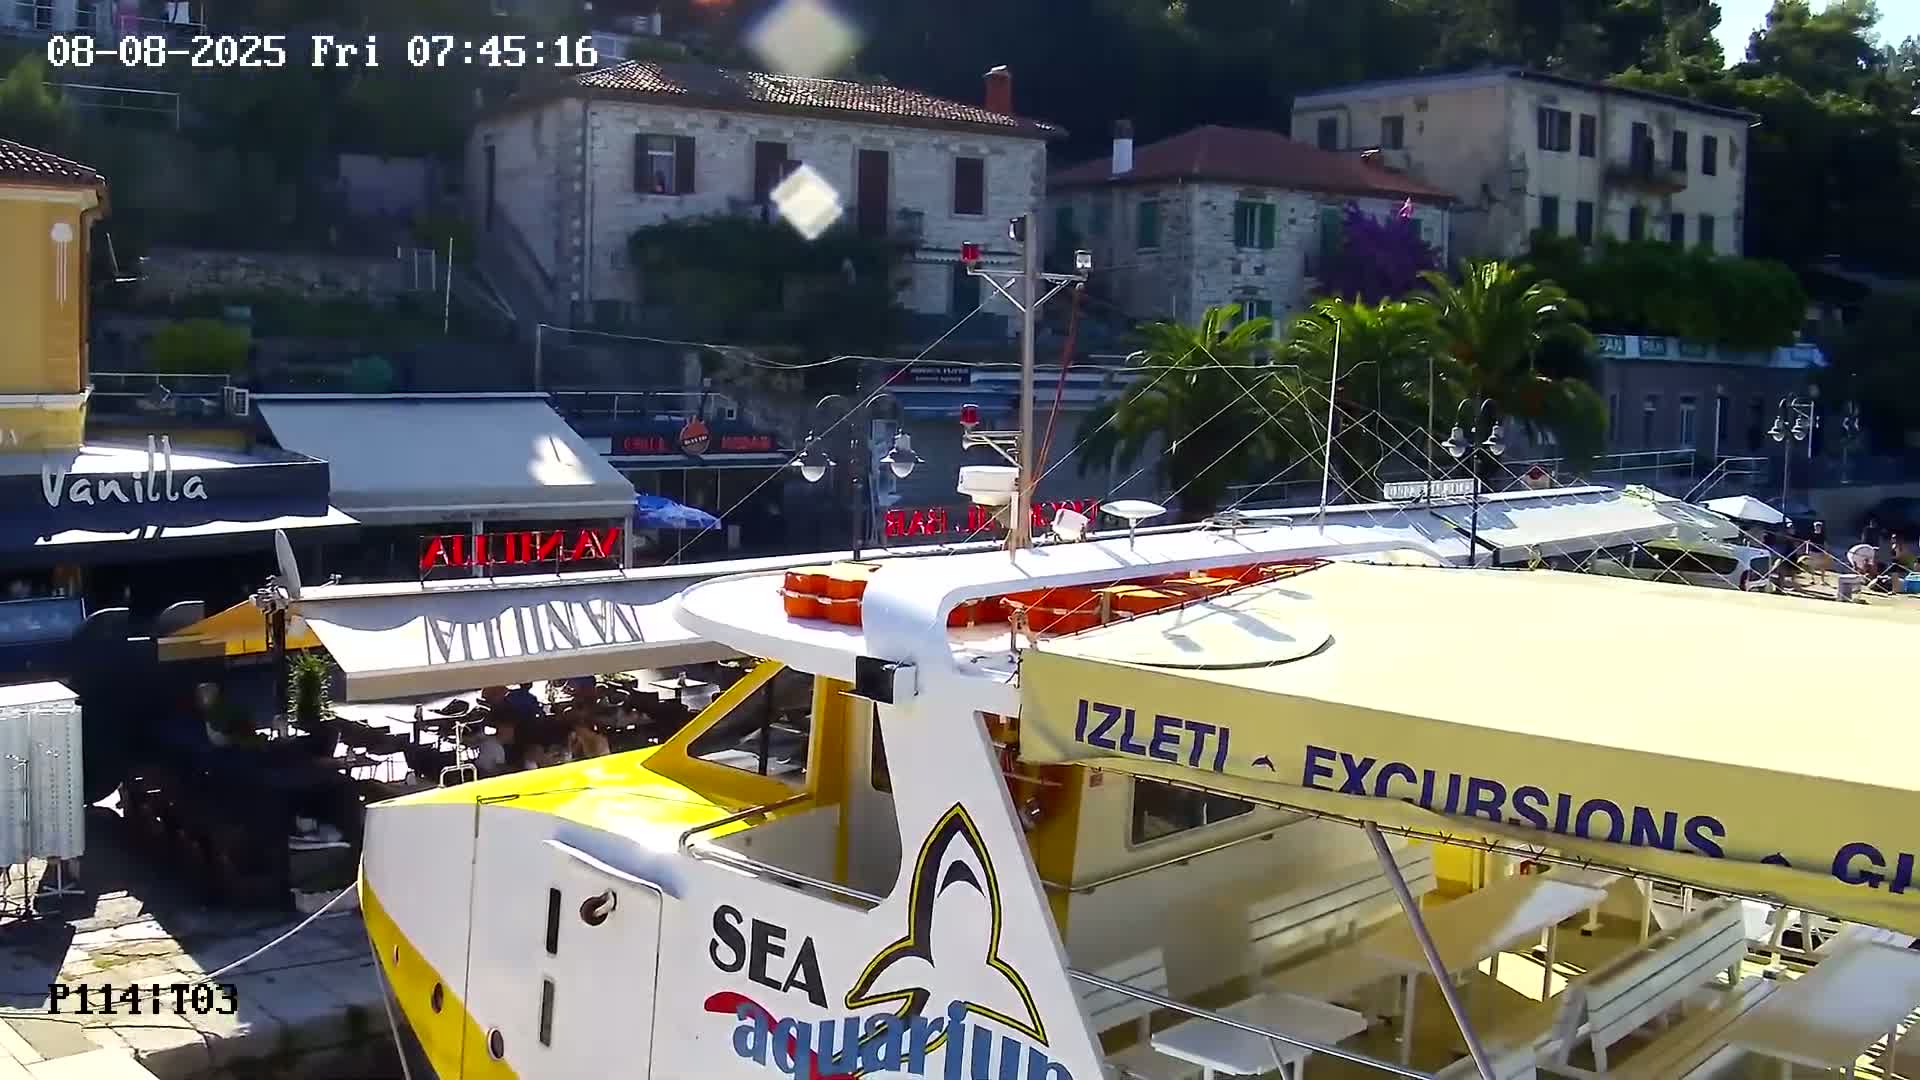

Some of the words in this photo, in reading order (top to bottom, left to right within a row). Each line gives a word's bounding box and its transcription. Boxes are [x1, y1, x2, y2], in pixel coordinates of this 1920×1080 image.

[41, 433, 208, 508] Vanilla
[1075, 698, 1231, 774] IZLETI
[1303, 744, 1726, 860] EXCURSIONS
[709, 904, 828, 1010] SEA
